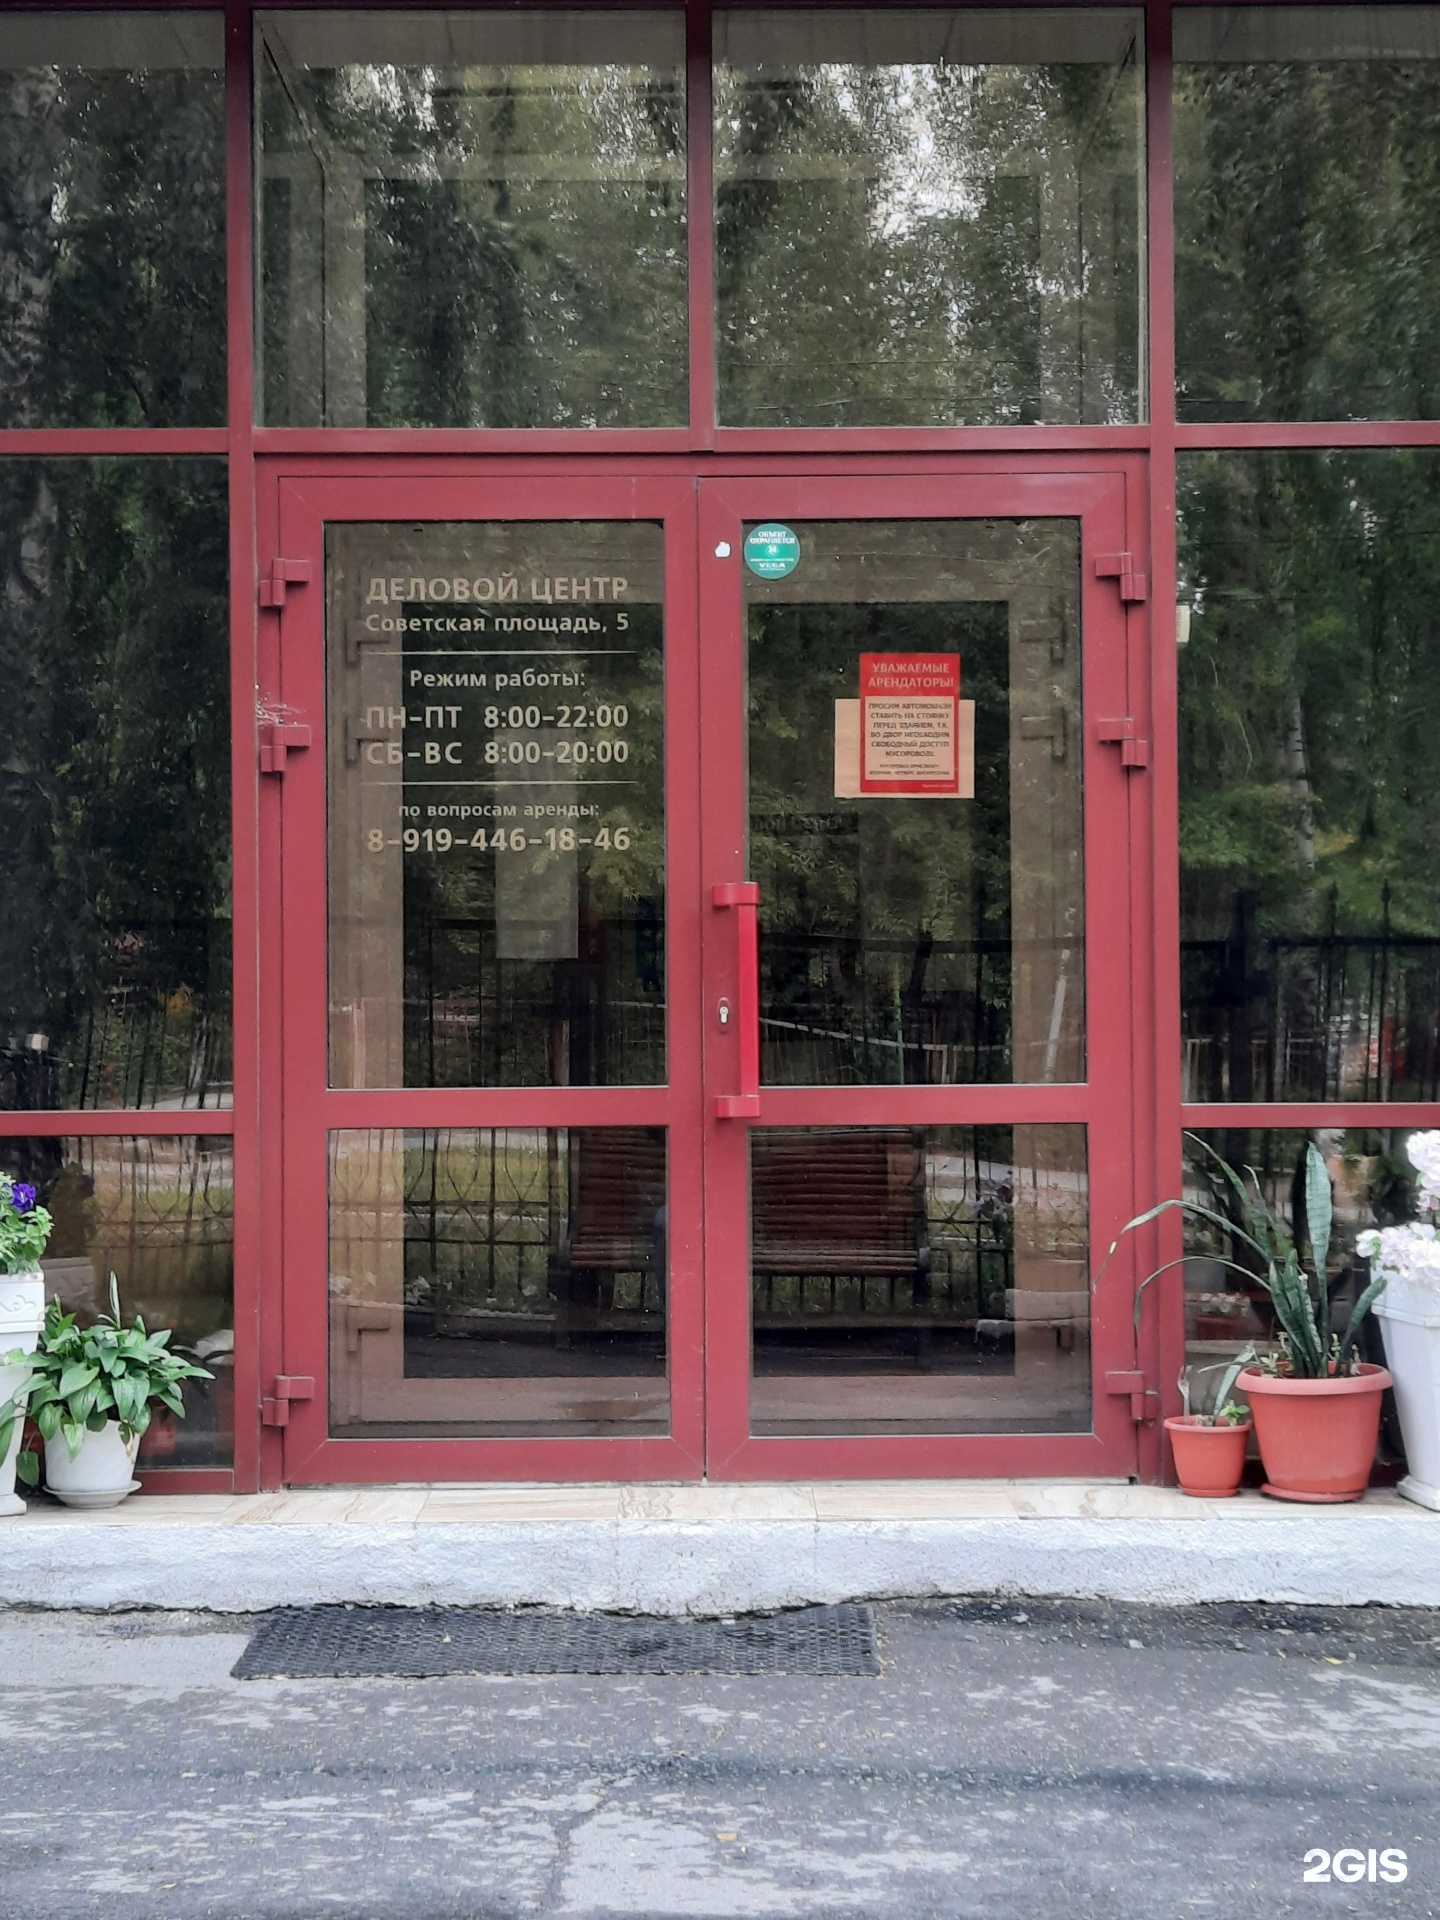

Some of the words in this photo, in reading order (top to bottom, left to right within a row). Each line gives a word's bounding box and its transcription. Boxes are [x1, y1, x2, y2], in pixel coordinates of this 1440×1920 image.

[366, 572, 518, 604] ДЕЛОВОЙ
[531, 577, 629, 604] ЦЕНТР
[366, 614, 486, 632] Советская
[494, 615, 607, 633] площадь,
[616, 613, 629, 630] 5
[410, 670, 487, 687] Режим
[495, 668, 586, 691] работы:
[872, 663, 950, 674] УВАЖАЕМЫЕ
[868, 677, 954, 689] АРЕНДАТОРЫ!
[366, 706, 462, 728] ПН-ПТ
[484, 705, 629, 728] 8:00-22:00
[366, 742, 462, 764] СБ-ВС
[484, 741, 629, 764] 8:00-20:00
[399, 805, 421, 817] по
[427, 804, 517, 819] вопросам
[523, 804, 600, 819] аренды:
[367, 827, 631, 852] 8-919-446-18-46
